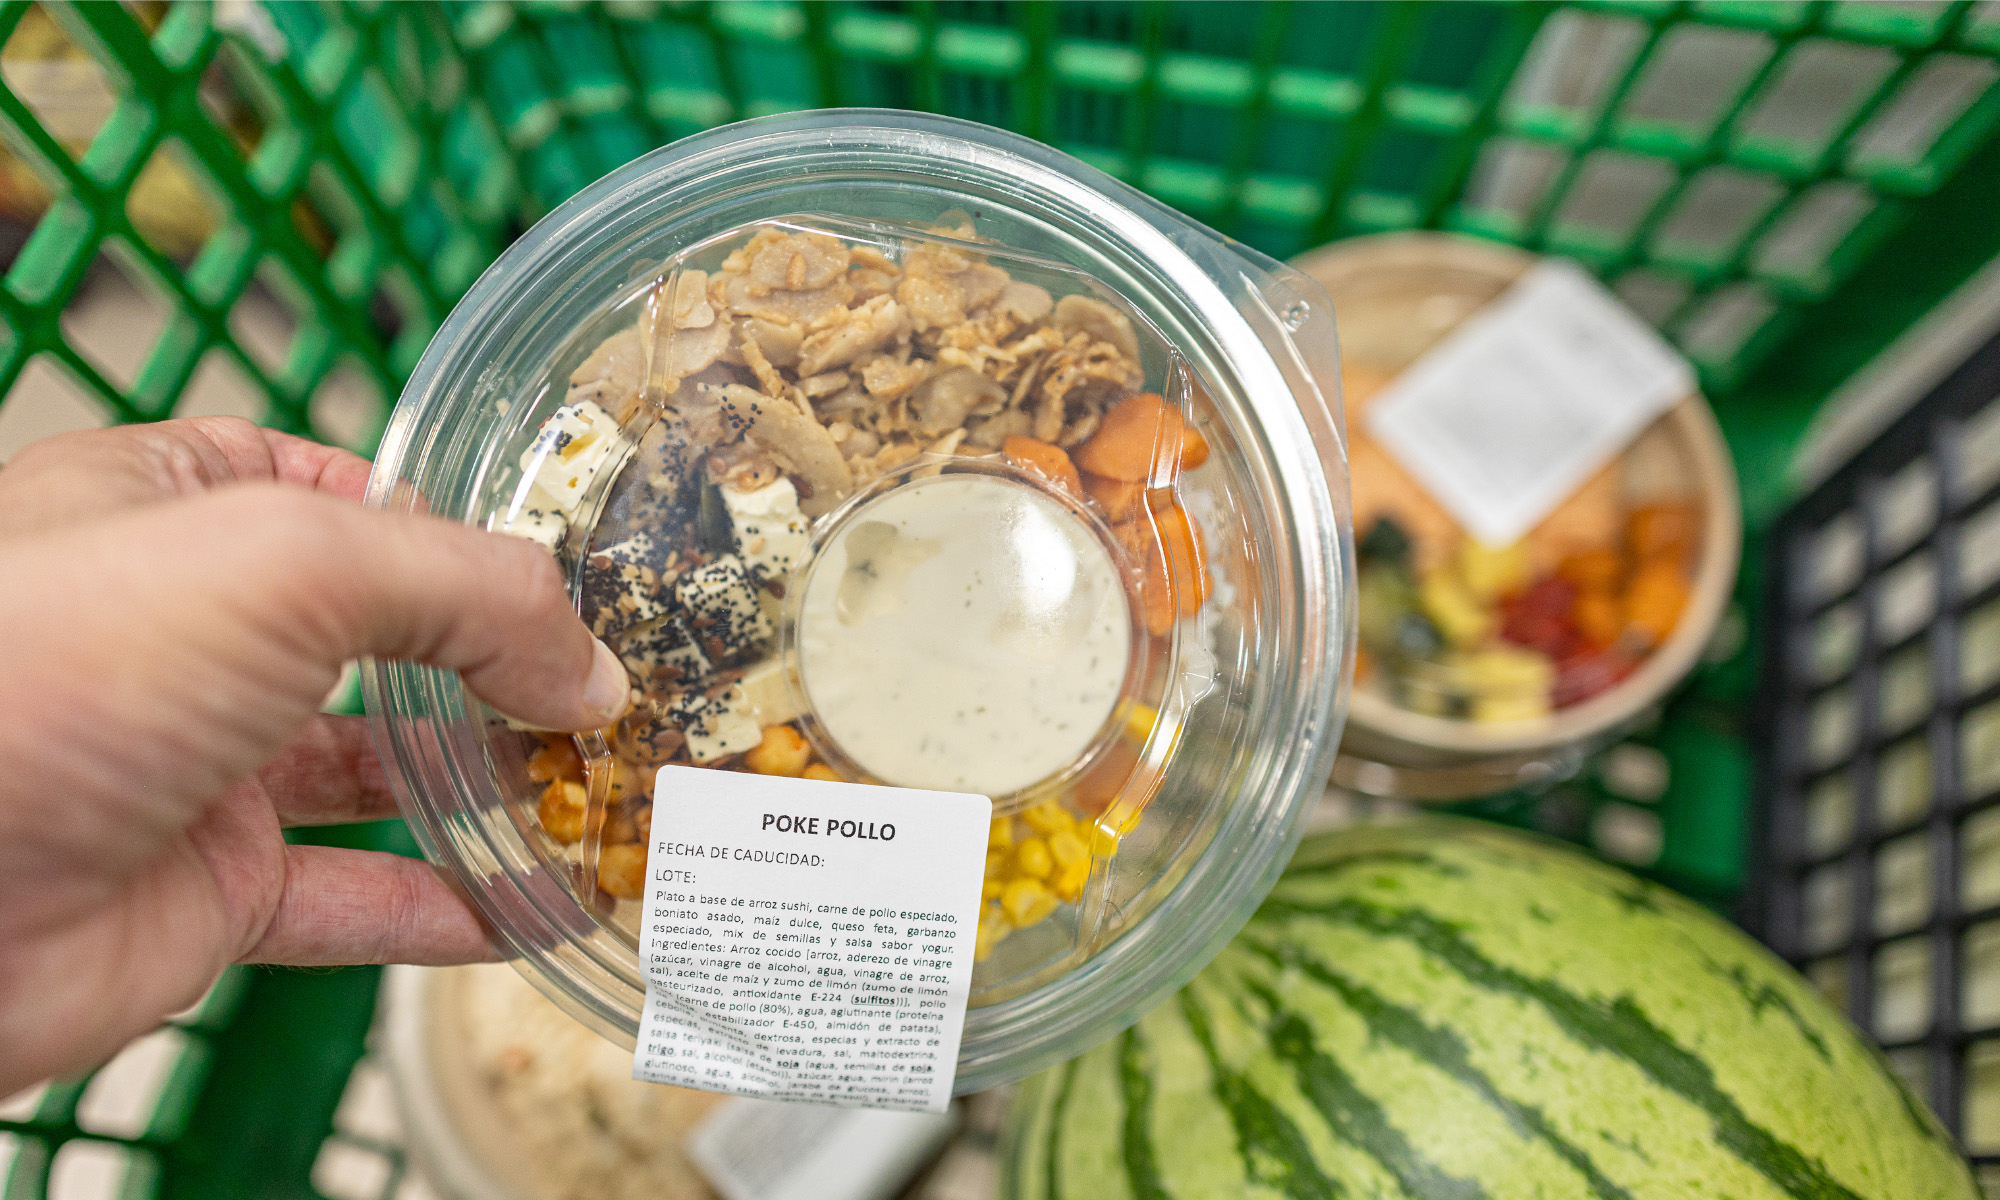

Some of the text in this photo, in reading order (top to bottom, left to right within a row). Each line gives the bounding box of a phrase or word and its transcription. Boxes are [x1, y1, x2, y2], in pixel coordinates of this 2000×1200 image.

[762, 813, 896, 841] POKE POLLO
[658, 842, 825, 868] FECHA DE CADUCIDAD:
[656, 869, 696, 884] LOTE:
[656, 890, 958, 924] Plato a base de arroz sushi, carne de pollo especiado,
[654, 906, 956, 939] boniato asado, maíz dulce, queso feta, garbanzo
[652, 924, 954, 954] especiado, mix de semillas y salsa sabor yogur.
[652, 938, 726, 953] Ingredientes:
[730, 944, 760, 956] Arroz
[766, 948, 802, 958] cocido
[846, 952, 890, 964] aderezo
[894, 956, 908, 966] de
[913, 958, 953, 970] vinagre
[650, 953, 950, 984] (azúcar, vinagre de alcohol, agua, vinagre de arroz,
[650, 966, 948, 996] sal), aceite de maíz y zumo de limón (zumo de limón
[712, 1000, 726, 1009] de
[729, 1003, 756, 1012] pollo
[759, 1003, 794, 1016] (80%),
[797, 1008, 827, 1018] agua,
[830, 1008, 892, 1018] aglutinante
[896, 1010, 944, 1021] (proteína
[733, 990, 802, 1001] antioxidante
[811, 992, 842, 1002] E-224
[920, 1000, 946, 1009] pollo
[706, 1012, 774, 1027] estabilizador
[783, 1020, 818, 1030] E-450,
[826, 1020, 870, 1032] almidón
[878, 1022, 892, 1032] de
[650, 1029, 678, 1040] salsa
[760, 1054, 772, 1063] de
[776, 1060, 800, 1069] soja
[844, 1062, 886, 1072] semillas
[892, 1062, 905, 1072] de
[754, 1032, 804, 1044] dextrosa,
[812, 1036, 857, 1045] especias
[864, 1038, 870, 1046] y
[876, 1038, 920, 1046] extracto
[926, 1038, 940, 1046] de
[756, 1044, 769, 1052] de
[776, 1048, 826, 1058] levadura,
[860, 1050, 938, 1060] maltodextrina,
